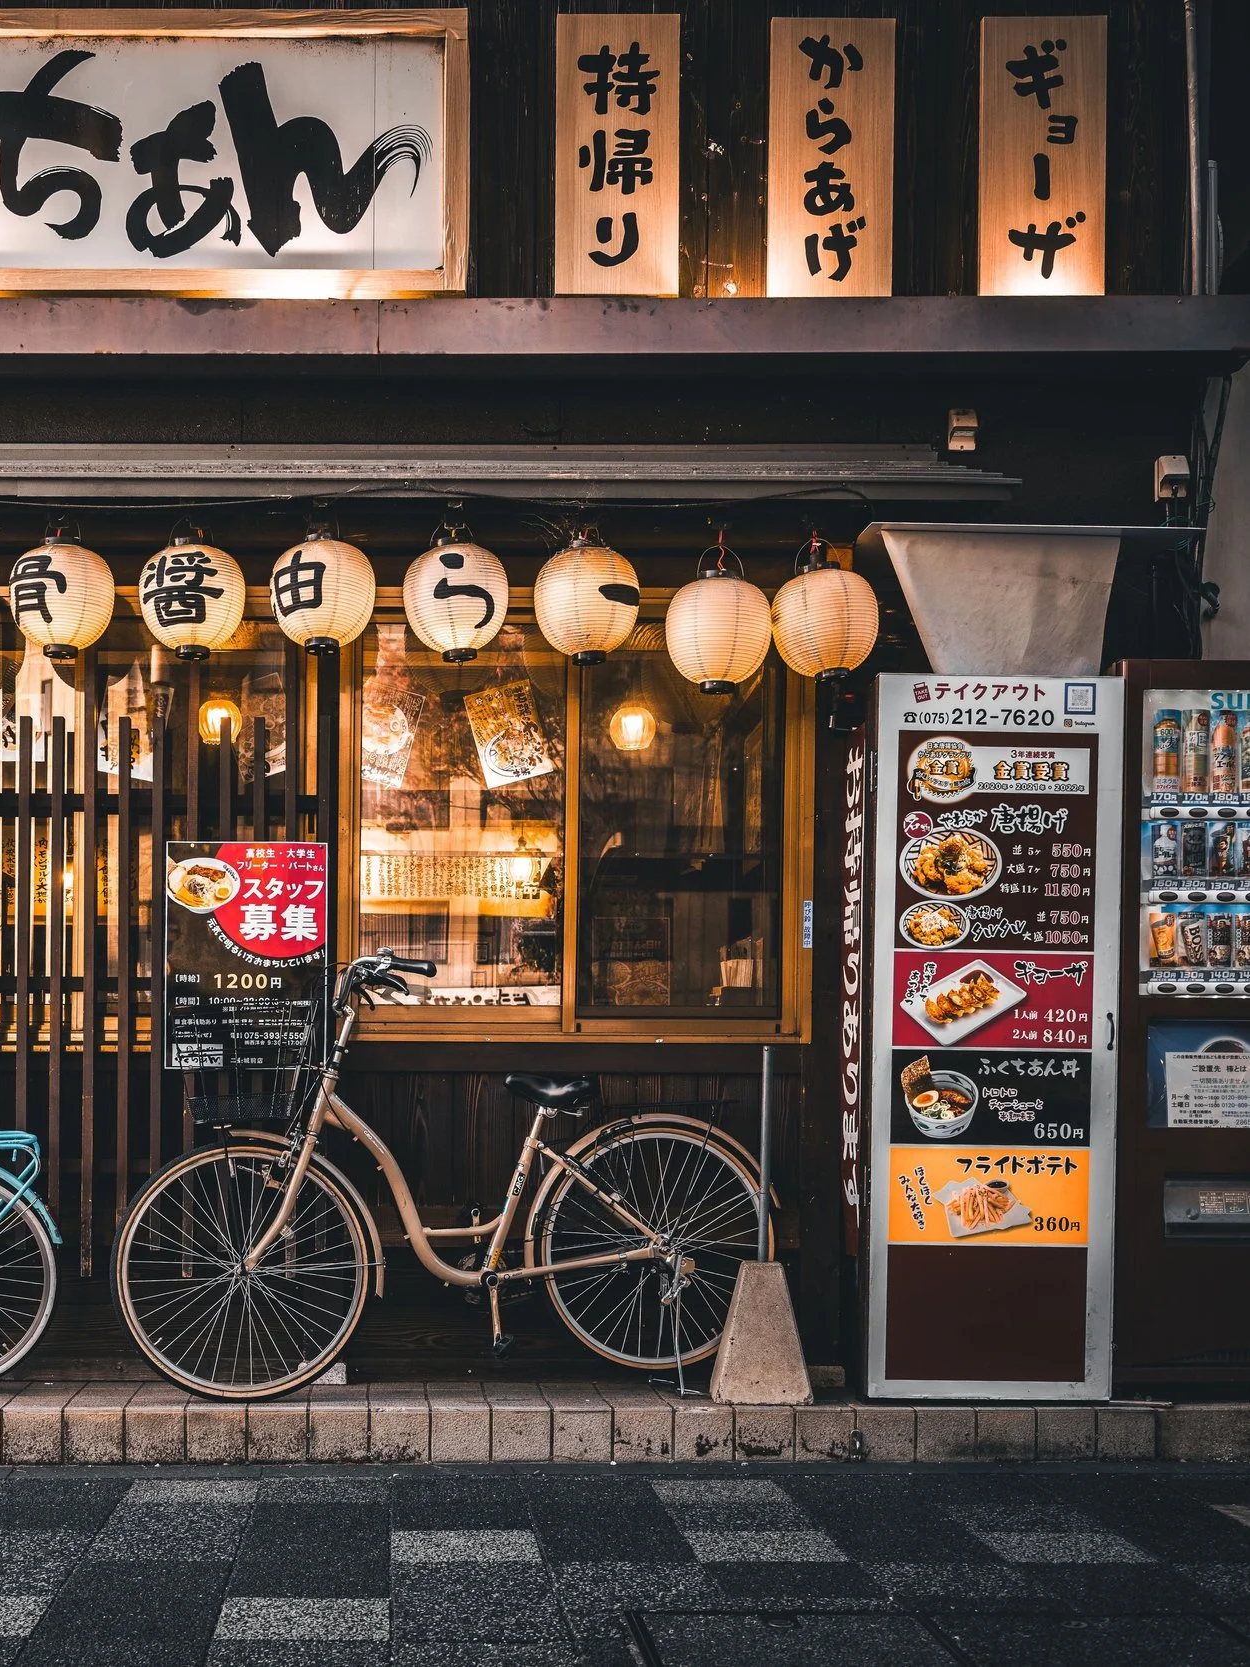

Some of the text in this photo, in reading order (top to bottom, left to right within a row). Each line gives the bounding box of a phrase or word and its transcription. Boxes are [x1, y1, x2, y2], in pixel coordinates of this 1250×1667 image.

[578, 40, 661, 268] 持帰り
[799, 33, 868, 284] からあげ
[1005, 38, 1086, 280] ギョーザ
[143, 550, 225, 627] 醤
[433, 552, 496, 629] ら
[914, 687, 928, 697] TAKE
[917, 693, 929, 701] OUT
[934, 682, 1047, 702] テイクアウト
[1211, 692, 1250, 710] SU
[918, 708, 1055, 727] (075)212-7620
[1010, 750, 1056, 759] 3年連続受賞
[929, 759, 960, 776] 金賞
[993, 760, 1070, 782] 金賞受賞
[937, 810, 988, 829] やわらか
[990, 803, 1068, 835] 唐揚げ
[245, 848, 316, 859] 高校生・大学生
[1012, 845, 1023, 856] 並
[1051, 844, 1091, 858] 550円
[1006, 863, 1026, 874] 大盛
[1050, 864, 1091, 877] 750円
[242, 877, 325, 900] スタッフ
[1000, 883, 1020, 894] 特盛
[1044, 883, 1090, 897] 1150円
[965, 905, 1003, 920] 唐揚げ
[1037, 911, 1089, 925] 並 750円
[239, 903, 319, 942] 募集
[1022, 930, 1089, 944] 大盛 1050円
[1189, 925, 1204, 964] BOSS
[213, 973, 282, 989] 1200円
[920, 961, 937, 1003] 焼きたて
[1014, 960, 1088, 987] ギョーザ
[905, 970, 921, 1006] あつあつ
[1013, 1008, 1088, 1023] 1人前 420円
[1012, 1028, 1088, 1044] 2人前 840円
[978, 1057, 1081, 1079] ふくちあん丼
[982, 1087, 1018, 1098] トロトロ
[988, 1099, 1044, 1111] チャーシューと
[1033, 1122, 1084, 1140] 650円
[956, 1154, 1078, 1176] フライドポテト
[914, 1166, 932, 1206] ほくほく
[899, 1175, 926, 1230] みんな大好き
[1034, 1216, 1081, 1232] 360円
